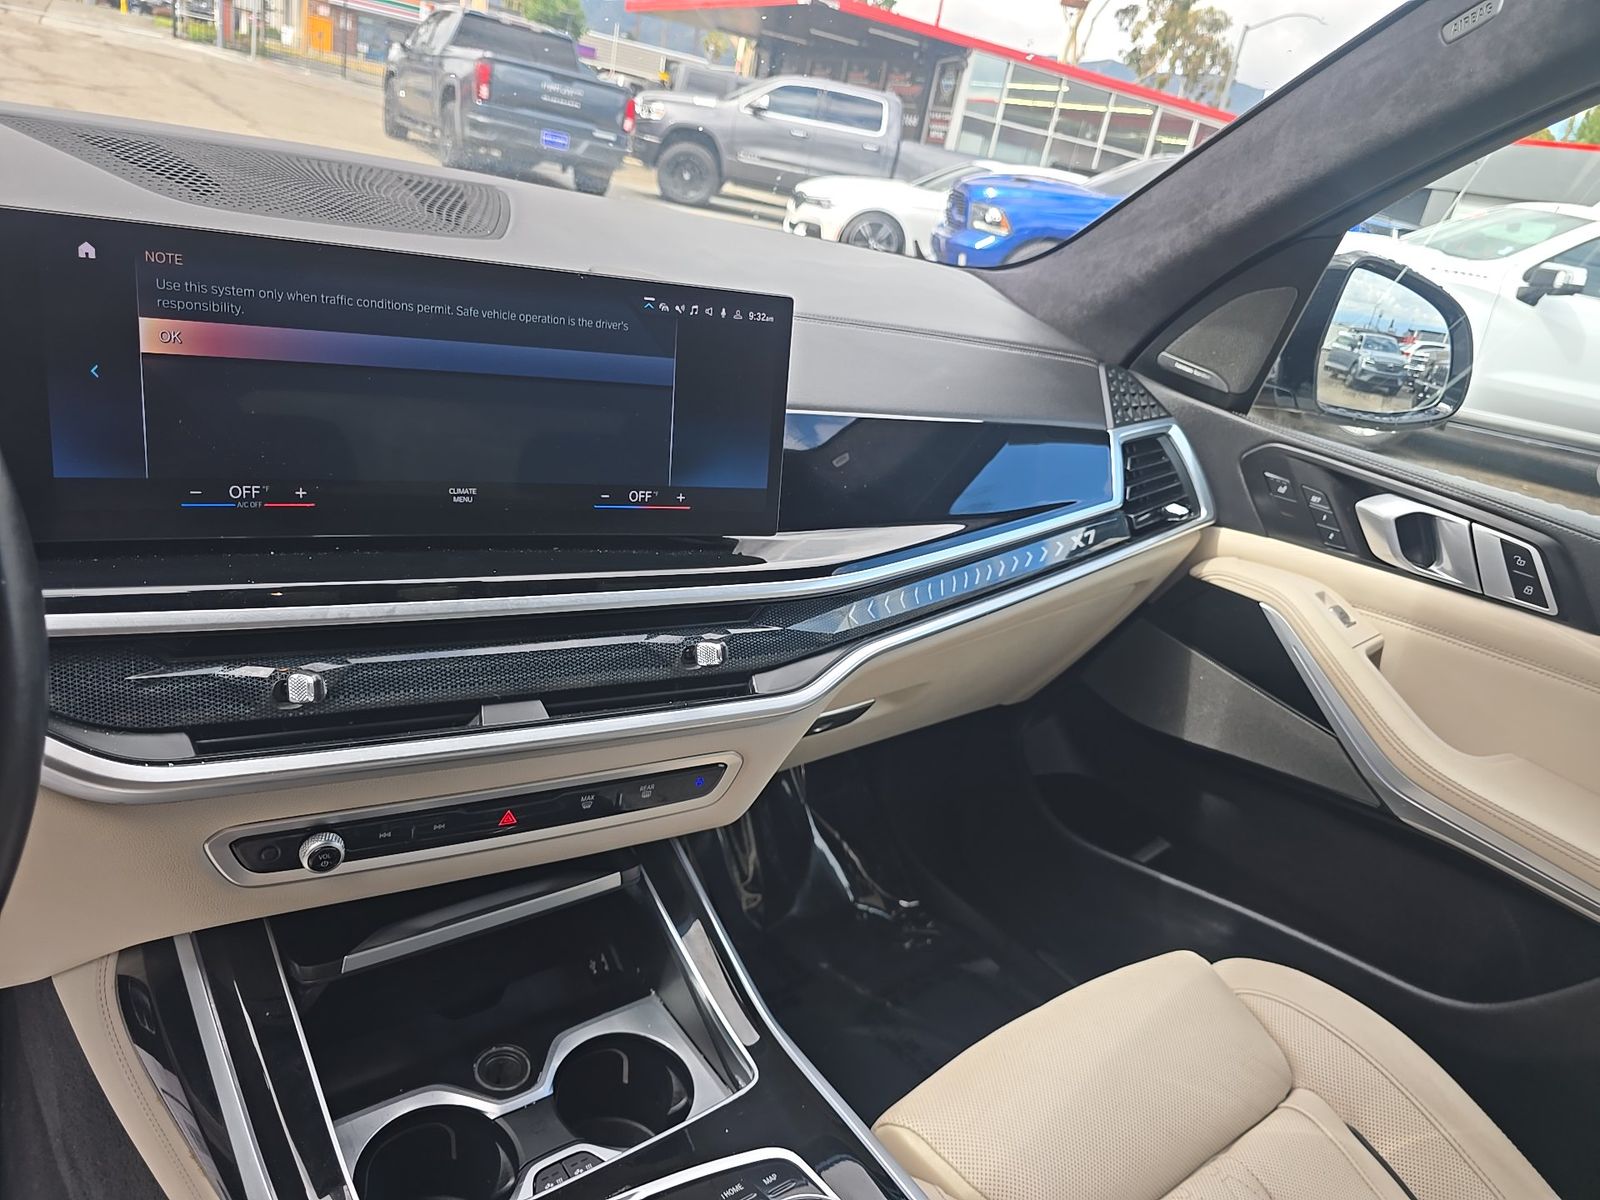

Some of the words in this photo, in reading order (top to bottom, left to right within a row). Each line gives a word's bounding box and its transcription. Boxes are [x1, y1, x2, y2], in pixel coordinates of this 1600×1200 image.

[1450, 2, 1493, 34] AIRBAG
[145, 251, 183, 265] NOTE
[155, 278, 181, 291] Use
[184, 281, 208, 294] this
[211, 285, 255, 298] system
[258, 288, 284, 302] only
[286, 290, 318, 303] when
[320, 293, 354, 306] traffic
[356, 296, 414, 312] conditions
[416, 302, 454, 316] permit.
[456, 305, 479, 318] Safe
[481, 308, 517, 321] vehicle
[518, 312, 566, 325] operation
[567, 315, 576, 326] is
[578, 317, 594, 328] the
[595, 319, 629, 331] driver's
[157, 297, 245, 316] responsibility.
[159, 330, 182, 344] OK
[229, 485, 261, 499] OFF
[448, 487, 478, 495] CLIMATE
[628, 490, 653, 502] OFF
[1071, 529, 1096, 551] X7
[640, 783, 655, 792] REAR
[581, 794, 595, 802] MAX
[762, 1173, 778, 1186] MAP
